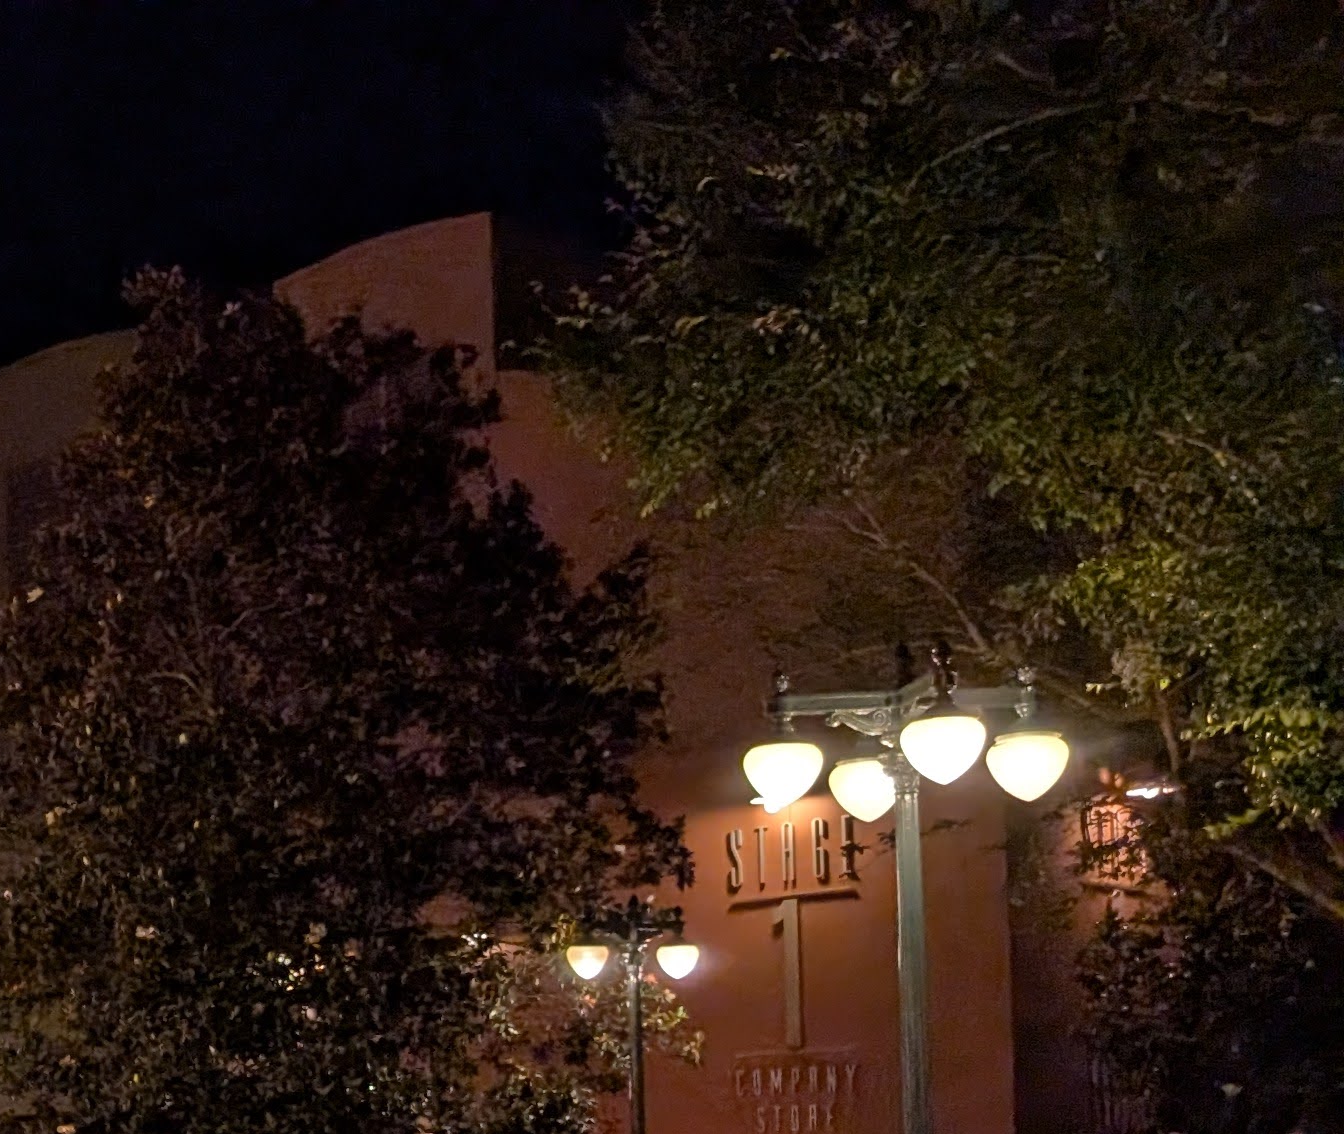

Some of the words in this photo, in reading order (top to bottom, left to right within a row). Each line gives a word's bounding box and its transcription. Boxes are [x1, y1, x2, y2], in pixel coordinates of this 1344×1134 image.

[727, 813, 853, 889] STAGE
[735, 1064, 856, 1097] COMPANY
[756, 1103, 834, 1133] STORE
